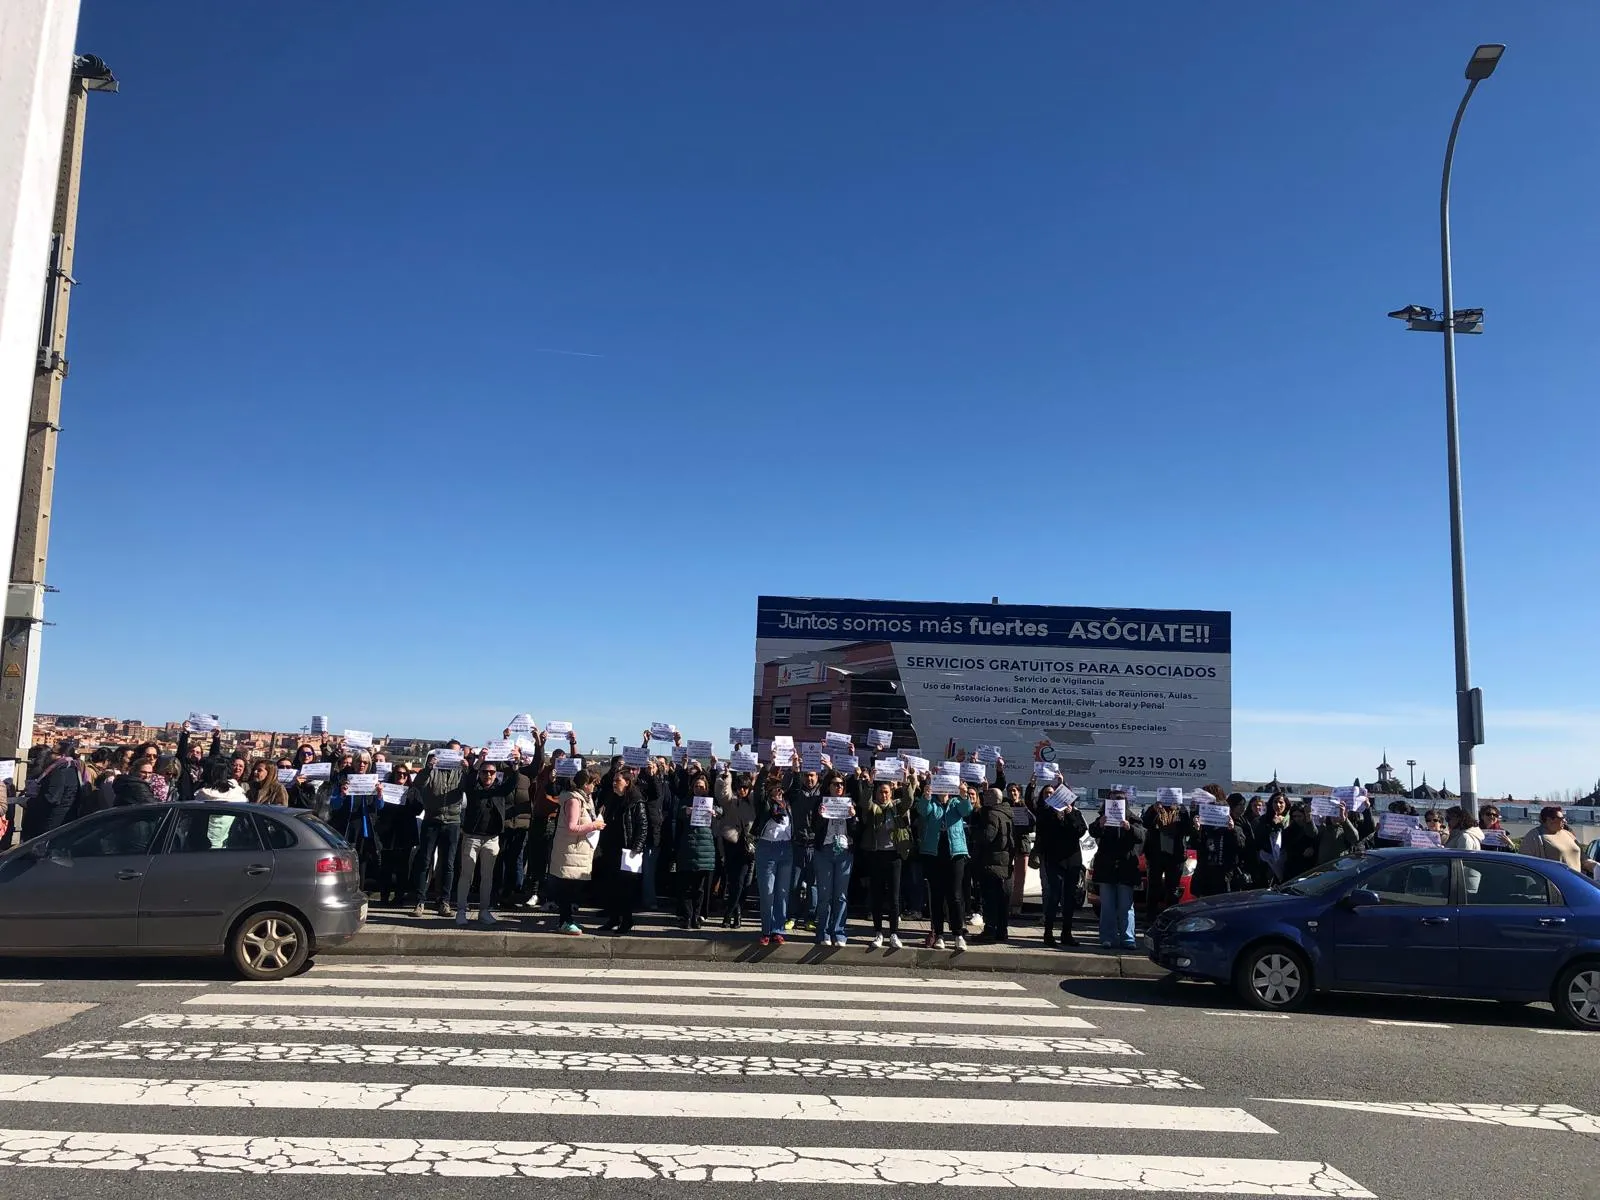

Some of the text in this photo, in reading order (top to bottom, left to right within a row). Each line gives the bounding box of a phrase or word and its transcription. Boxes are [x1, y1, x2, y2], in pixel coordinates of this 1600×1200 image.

[778, 613, 1210, 643] Juntos somos más fuertes ASÓCIATE!!
[907, 656, 1217, 678] SERVICIOS GRATUITOS PARA ASOCIADOS
[923, 682, 939, 690] Uso
[1014, 674, 1048, 683] Servicio
[1063, 677, 1105, 686] Vigilancia
[954, 694, 991, 702] Asesoría
[1099, 700, 1132, 708] Laboral
[1140, 701, 1165, 710] Penal
[1021, 708, 1097, 719] Control de Plagas
[952, 716, 998, 725] Conciertos
[1017, 719, 1059, 728] Empresas
[1068, 721, 1119, 730] Descuentos
[1121, 723, 1167, 732] Especiales
[1118, 756, 1207, 770] 923 19 01 49
